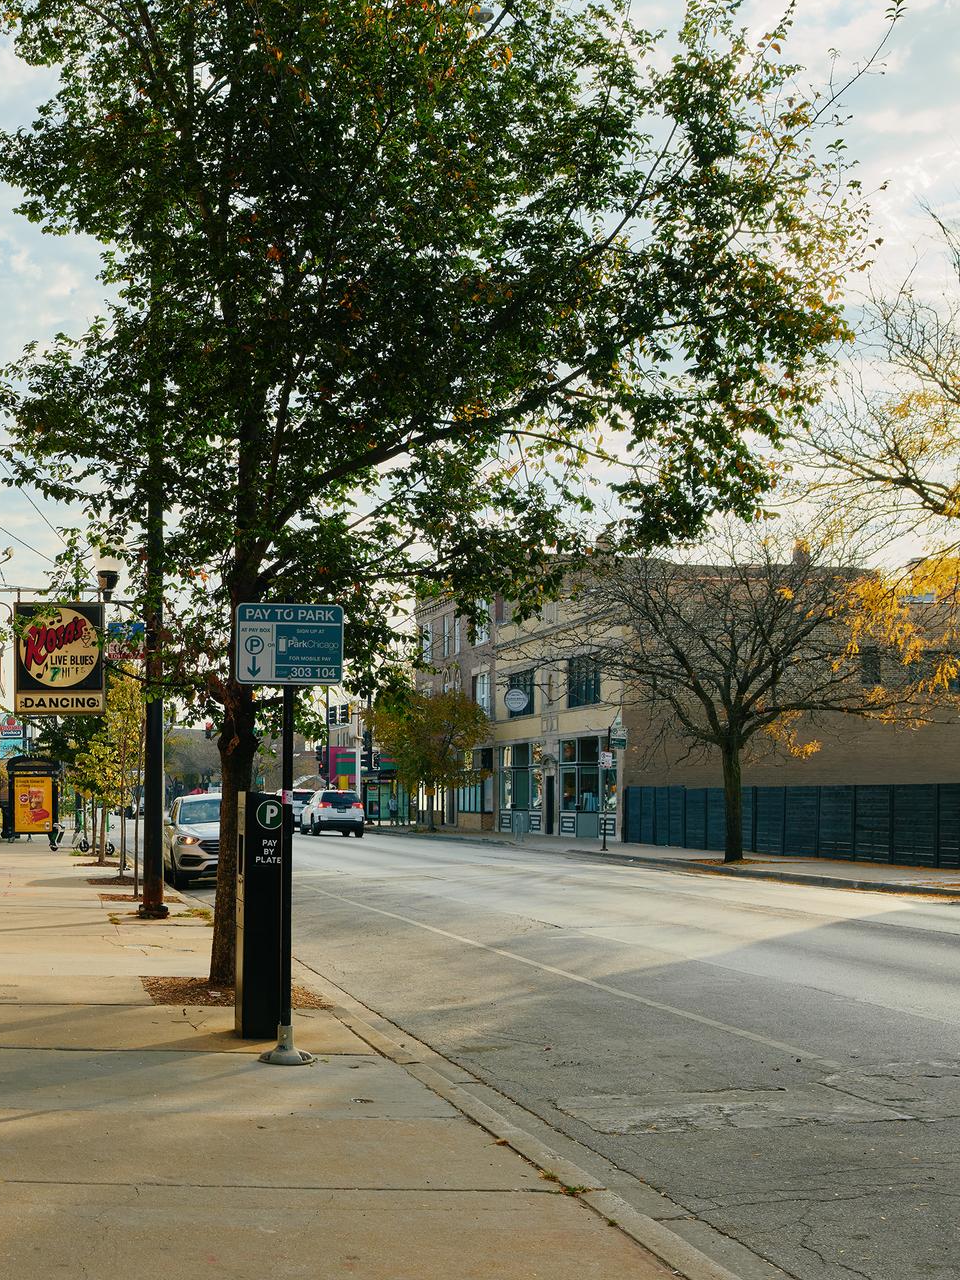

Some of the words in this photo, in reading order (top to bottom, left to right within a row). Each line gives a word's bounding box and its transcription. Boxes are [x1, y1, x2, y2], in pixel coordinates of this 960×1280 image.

[245, 608, 271, 620] PAY
[275, 609, 294, 620] TO
[298, 610, 335, 621] PARK
[288, 639, 340, 651] ParkChicago
[50, 655, 67, 665] LIVE
[70, 655, 95, 666] BLUES
[50, 667, 61, 682] 7
[291, 667, 312, 677] 303
[316, 668, 336, 678] 104
[24, 697, 96, 708] DANCING
[265, 804, 279, 825] P
[262, 839, 278, 847] PAY
[255, 856, 282, 864] PLATE
